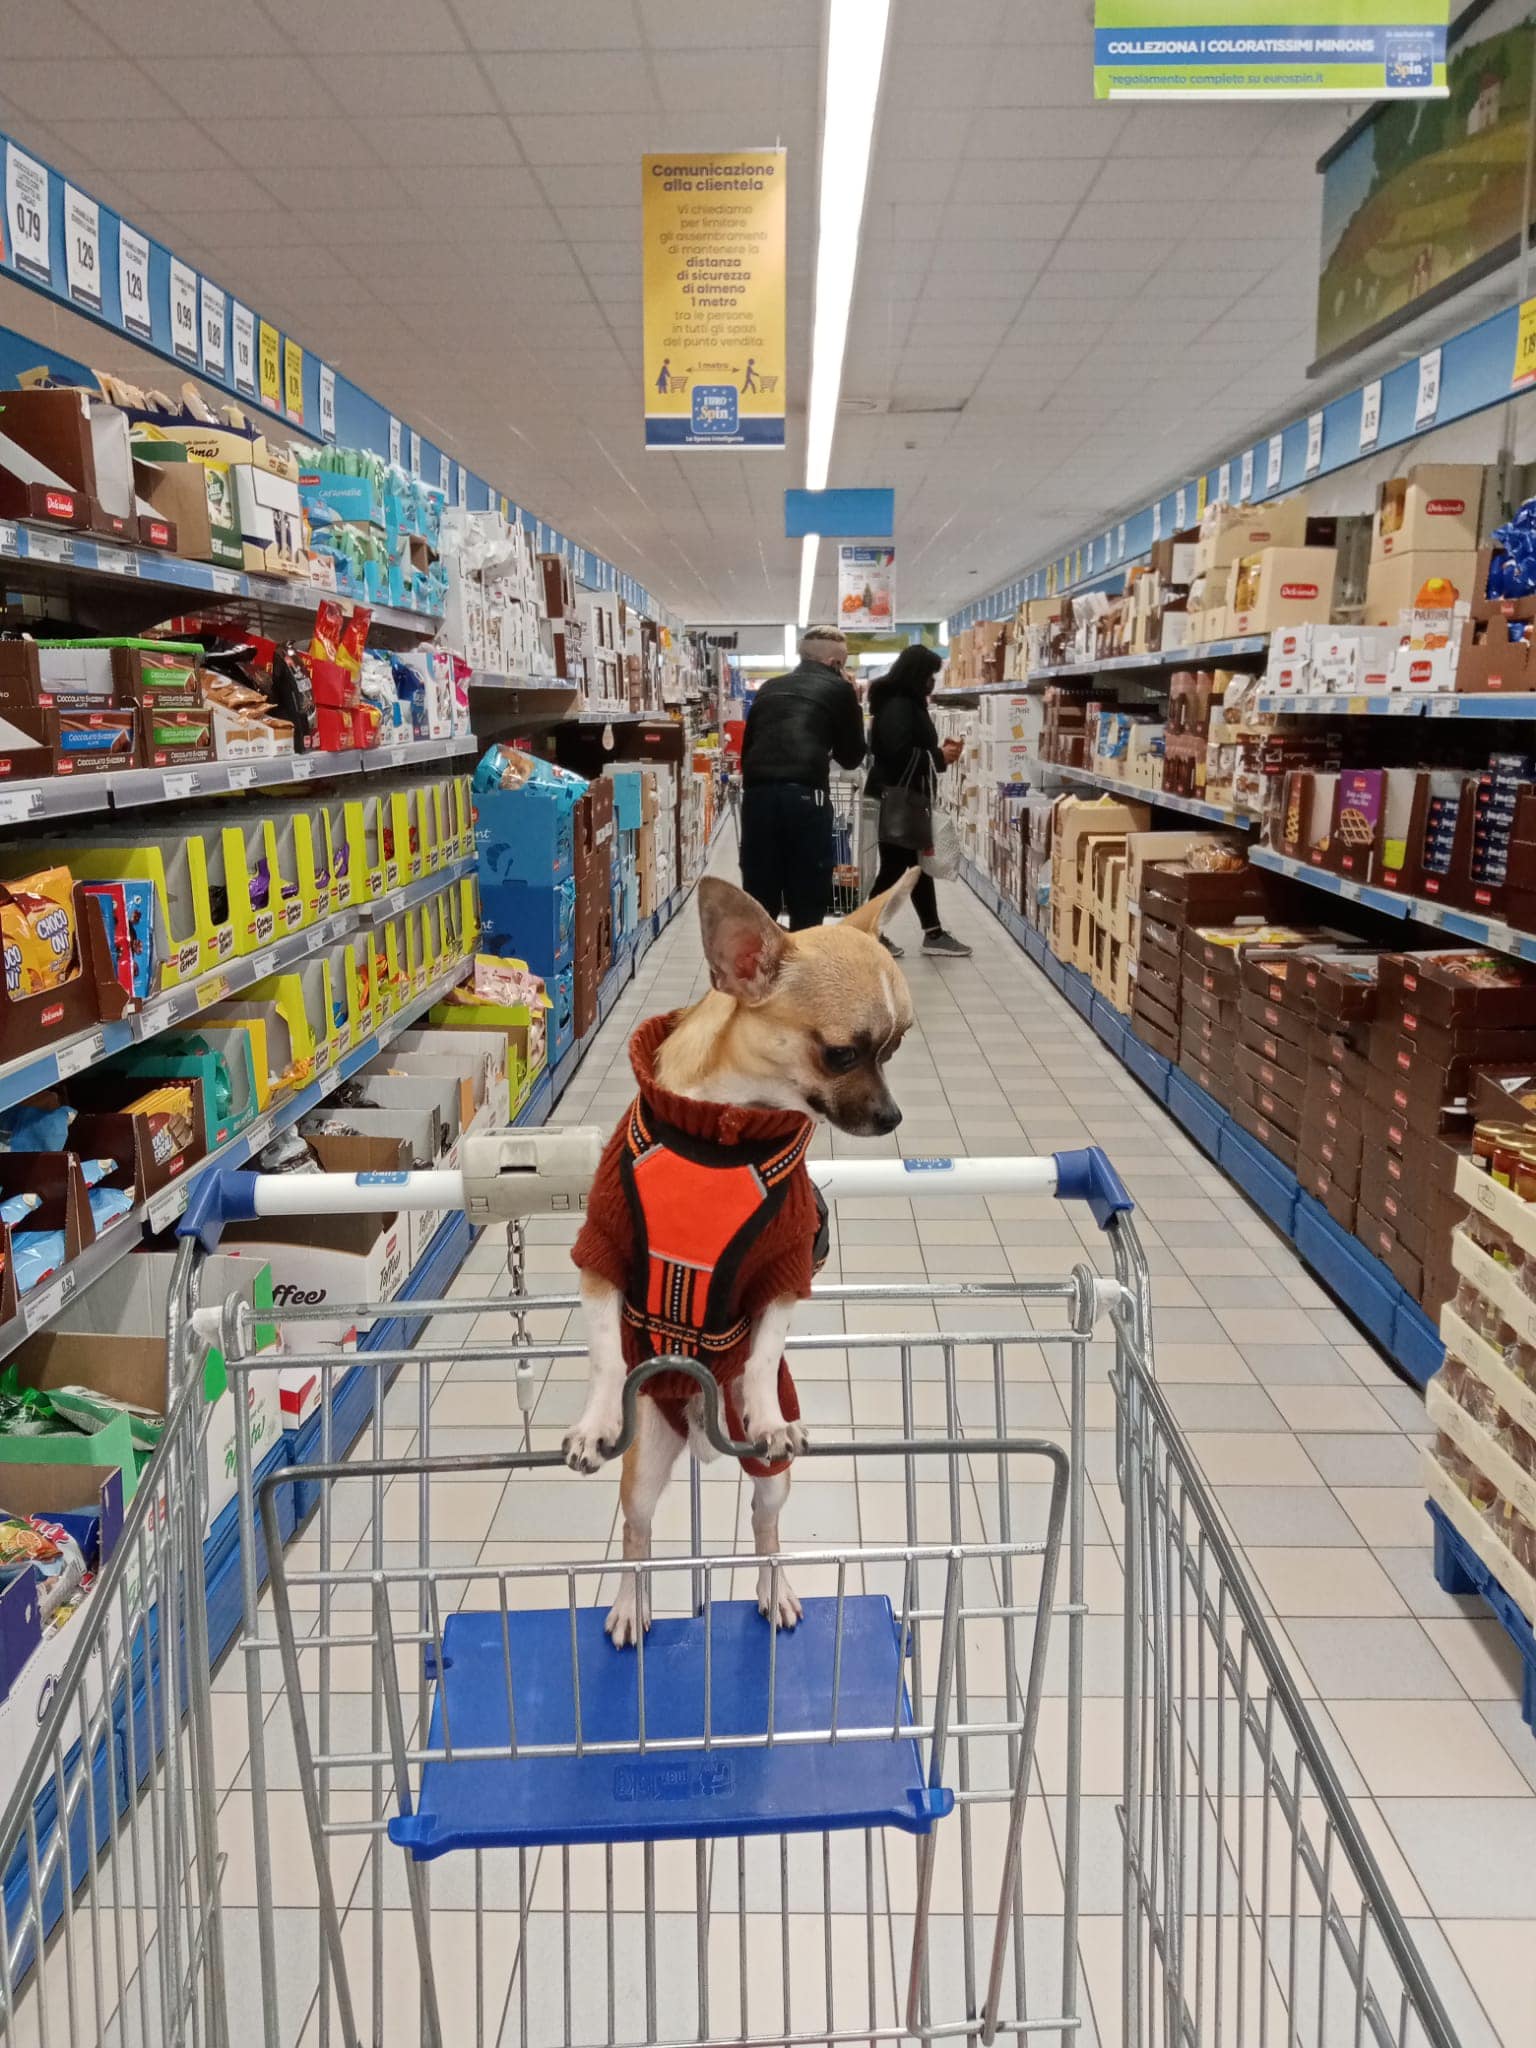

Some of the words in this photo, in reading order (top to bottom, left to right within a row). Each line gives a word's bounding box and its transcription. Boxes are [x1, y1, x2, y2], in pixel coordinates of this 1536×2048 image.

[1108, 41, 1198, 54] COLLEZIONA
[1201, 40, 1205, 52] I
[1208, 39, 1313, 52] COLORATISSIMI
[1315, 39, 1374, 51] MINIONS
[1190, 74, 1244, 85] completo
[1248, 76, 1260, 84] su
[1264, 73, 1323, 85] eurospin.it
[652, 162, 774, 177] Comunicazione
[663, 179, 692, 191] alla
[696, 178, 763, 191] clientela
[691, 204, 752, 214] chiediamo
[17, 203, 40, 242] 0,79
[681, 219, 698, 230] per
[660, 231, 674, 244] gli
[77, 237, 94, 271] 1,29
[682, 245, 745, 254] mantenere
[686, 256, 741, 268] distanza
[677, 269, 689, 281] di
[691, 270, 751, 280] sicurezza
[682, 283, 694, 294] di
[697, 283, 746, 294] almeno
[699, 297, 737, 307] metro
[675, 311, 691, 320] tra
[707, 312, 753, 323] persone
[684, 338, 718, 348] punto
[701, 405, 728, 423] Spin
[36, 909, 68, 939] CHOCO
[272, 1284, 327, 1307] ffee
